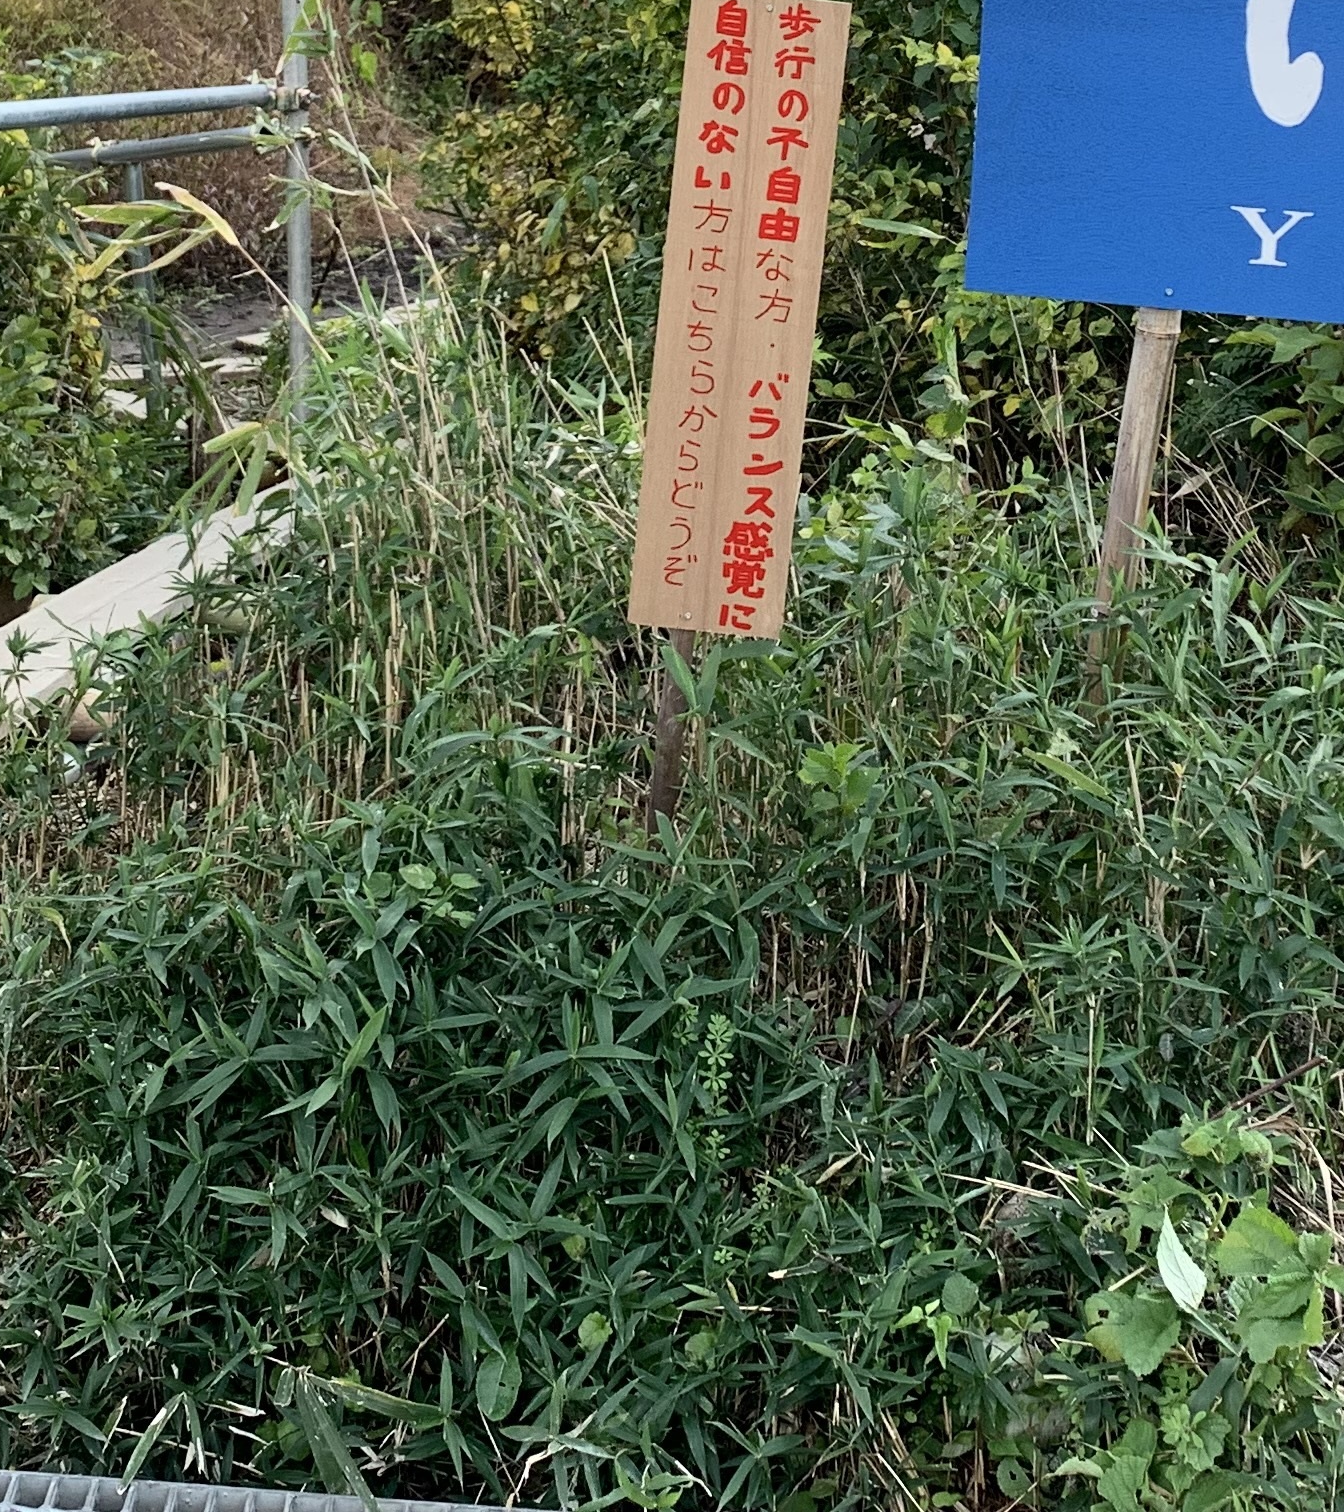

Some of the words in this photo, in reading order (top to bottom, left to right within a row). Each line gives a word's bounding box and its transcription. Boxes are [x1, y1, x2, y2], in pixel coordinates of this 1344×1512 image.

[663, 0, 753, 586] 自信のない方はこちらからどうぞ
